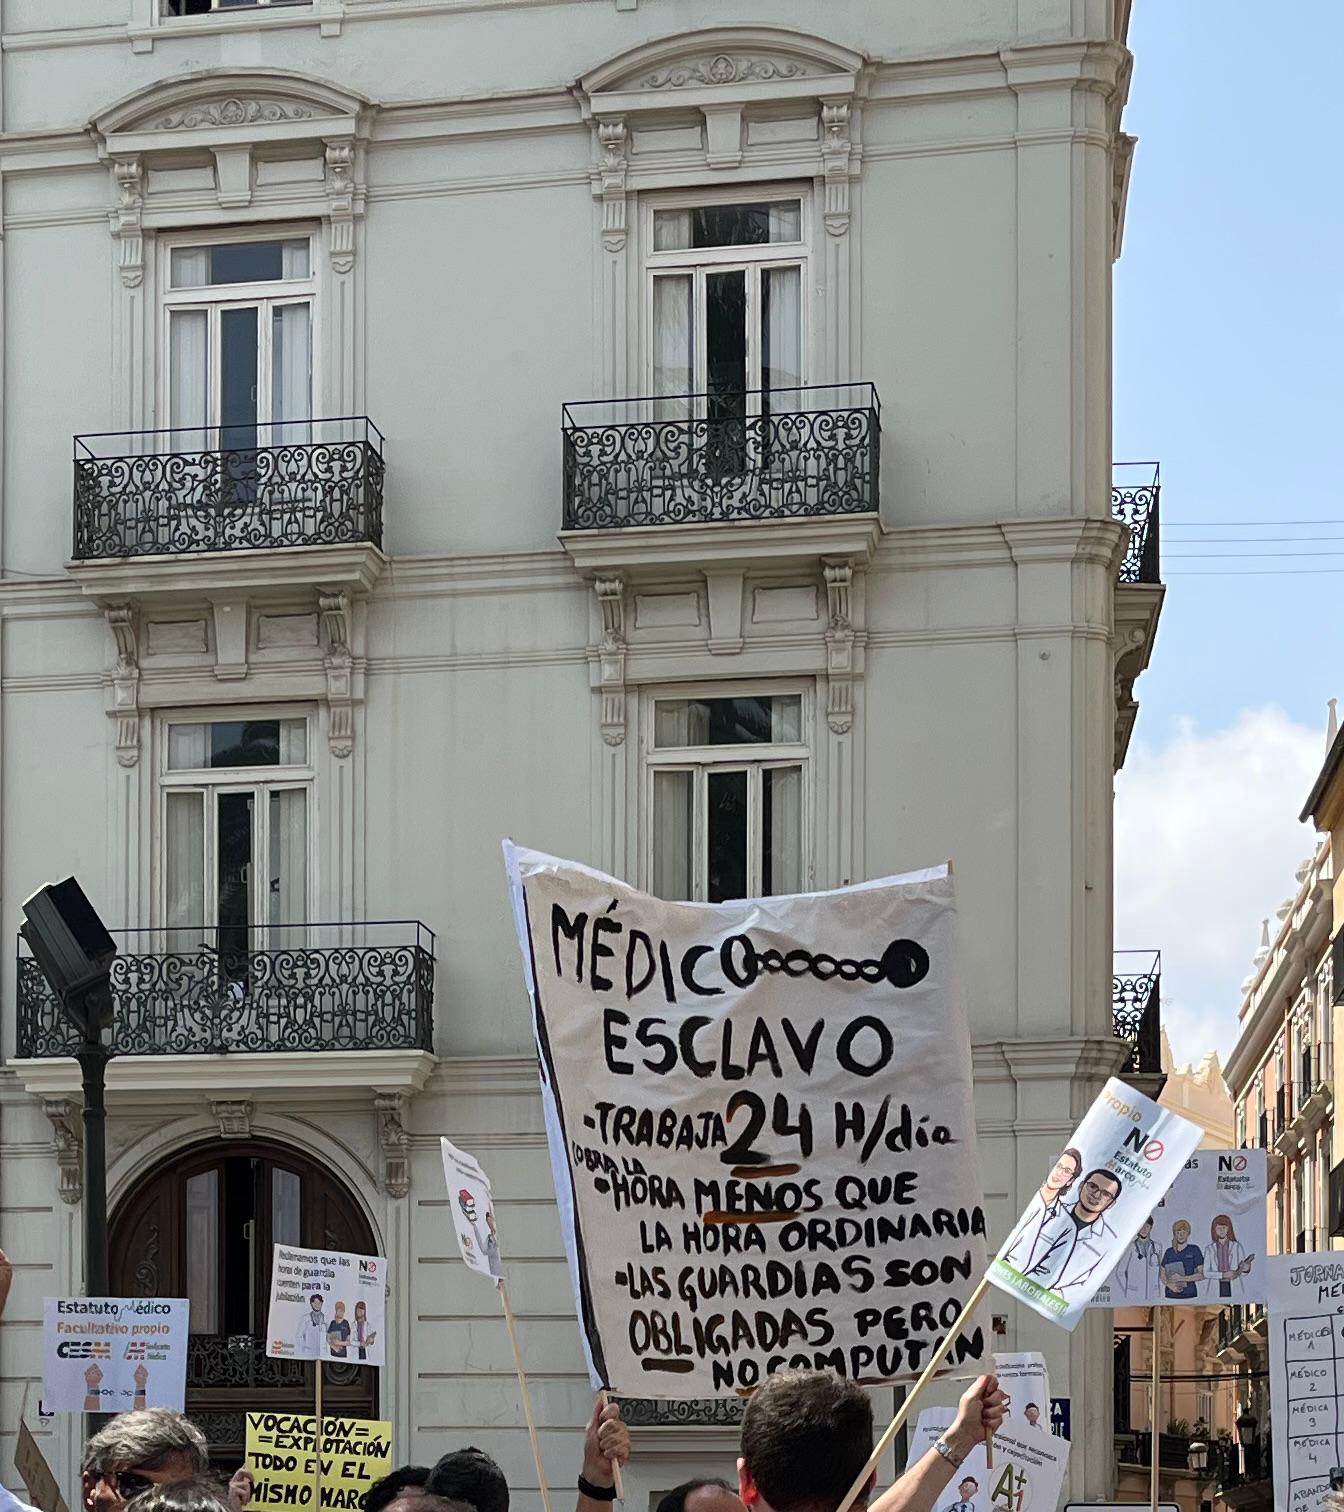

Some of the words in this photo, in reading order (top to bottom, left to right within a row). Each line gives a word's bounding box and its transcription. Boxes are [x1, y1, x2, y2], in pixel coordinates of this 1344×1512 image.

[551, 899, 756, 1004] MÉDICO
[602, 1007, 894, 1081] ESCLAVO
[719, 1090, 814, 1166] 24
[621, 1156, 648, 1177] LA
[1113, 1150, 1154, 1180] Estatuto
[1217, 1175, 1251, 1184] Estatuto
[694, 1177, 823, 1216] MENOS
[835, 1172, 918, 1211] QUE
[639, 1220, 673, 1254] LA
[683, 1222, 766, 1257] HORA
[778, 1205, 988, 1253] ORDINARIA
[678, 1253, 875, 1315] GUARDIAS
[883, 1249, 972, 1288] SON
[57, 1300, 119, 1315] Estatuto
[57, 1321, 128, 1335] Facultativo
[131, 1321, 171, 1337] propio
[628, 1306, 835, 1359] OBLIGADAS
[853, 1298, 963, 1341] PERO
[712, 1356, 760, 1391] NO
[1290, 1366, 1328, 1380] MÉDICO
[1309, 1382, 1318, 1393] 2
[1292, 1402, 1329, 1414] MÉDICA
[1309, 1417, 1317, 1428] 3
[248, 1451, 297, 1472] TODO
[304, 1459, 333, 1476] EN
[341, 1461, 371, 1480] EL
[1308, 1454, 1317, 1464] 4
[249, 1478, 312, 1506] MISMO
[320, 1486, 368, 1511] MARC
